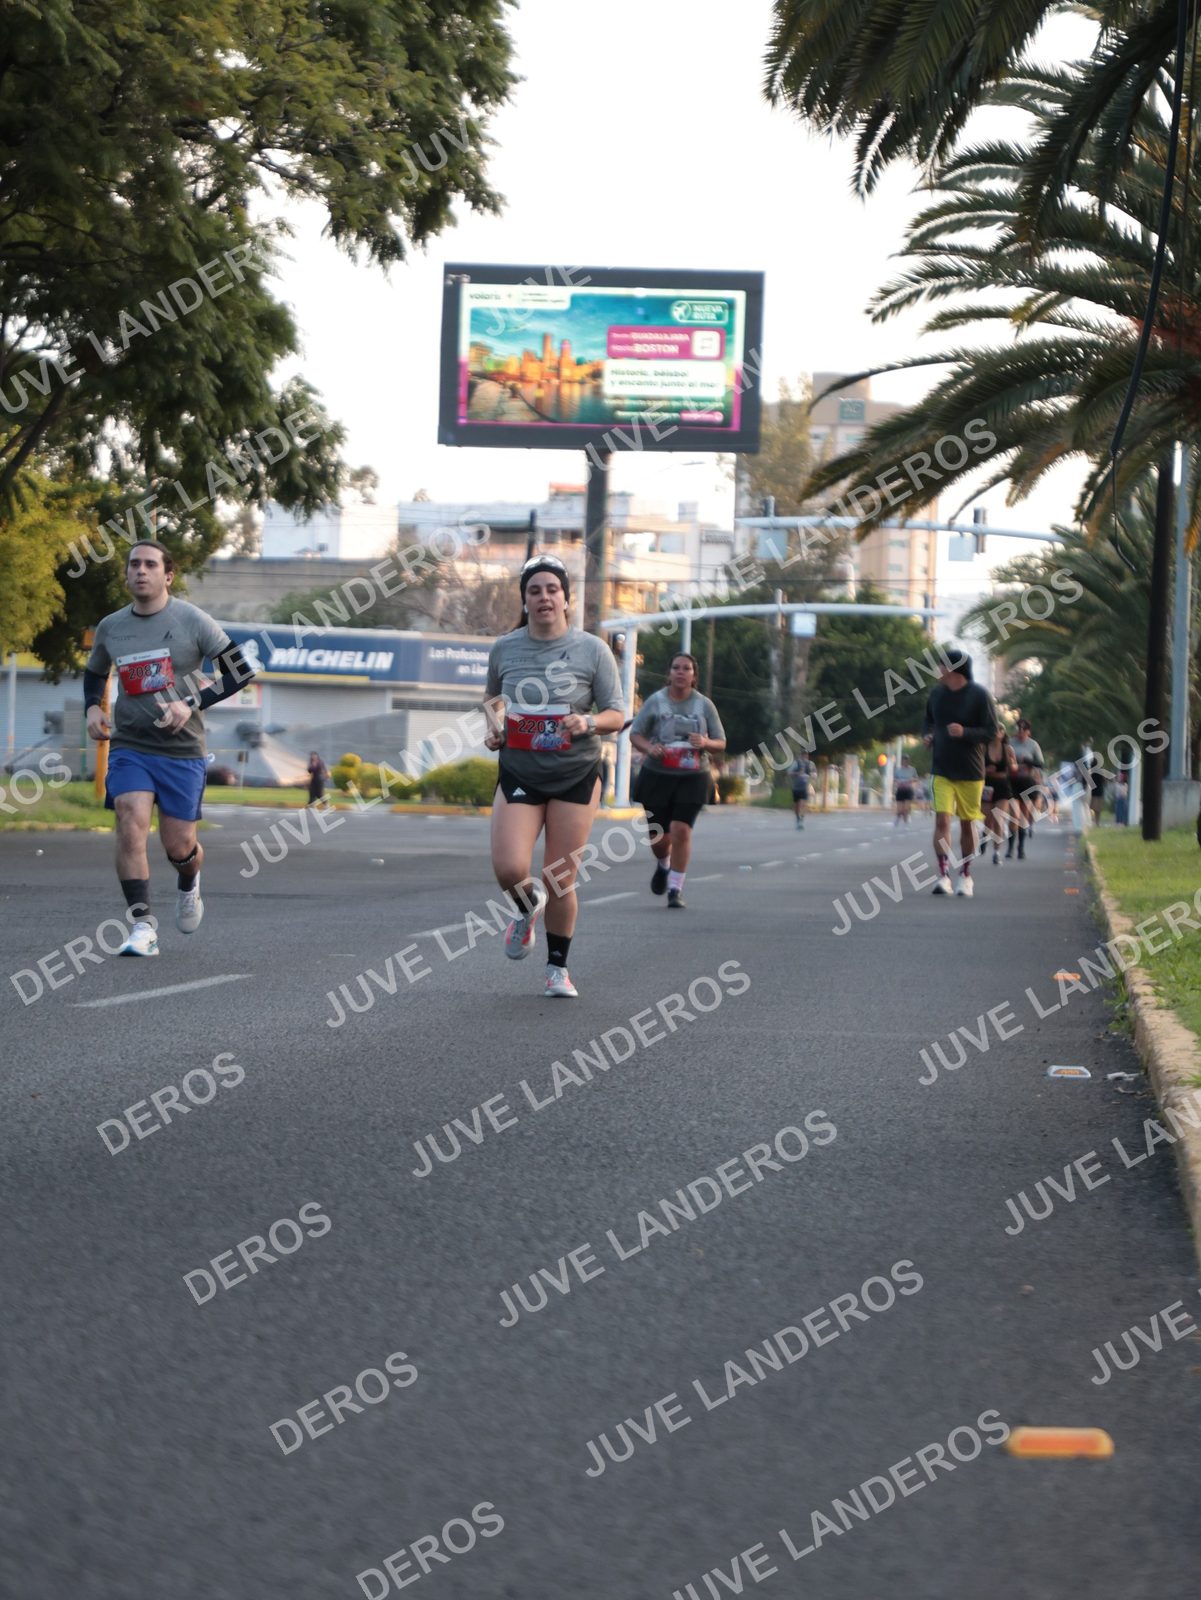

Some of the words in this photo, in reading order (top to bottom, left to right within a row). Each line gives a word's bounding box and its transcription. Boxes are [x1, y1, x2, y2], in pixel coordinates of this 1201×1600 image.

[633, 343, 680, 353] BOSTON
[269, 647, 395, 672] MICHELIN
[128, 663, 162, 681] 2087
[519, 720, 559, 734] 2203
